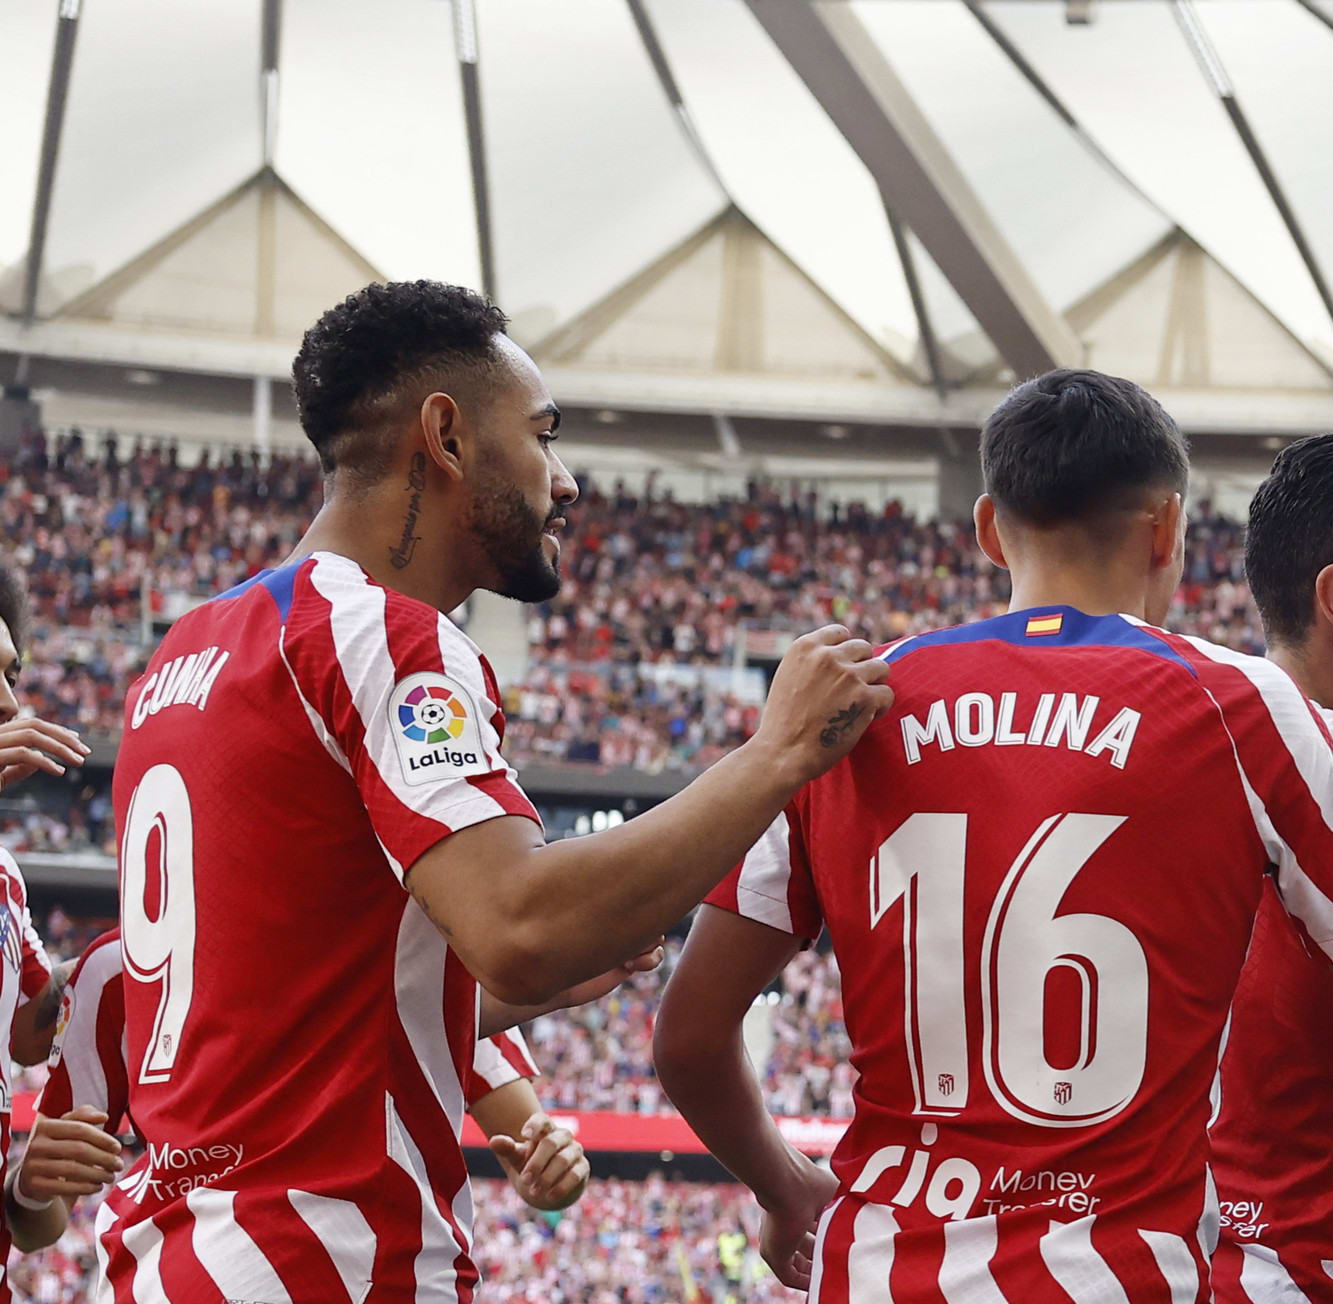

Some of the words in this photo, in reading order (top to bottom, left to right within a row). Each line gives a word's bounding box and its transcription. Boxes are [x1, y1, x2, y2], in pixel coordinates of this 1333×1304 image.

[131, 646, 230, 730] CUNHA
[409, 747, 478, 771] LaLiga
[900, 692, 1141, 770] MOLINA
[120, 763, 196, 1085] 9
[869, 812, 1149, 1128] 16
[150, 1142, 244, 1170] Money
